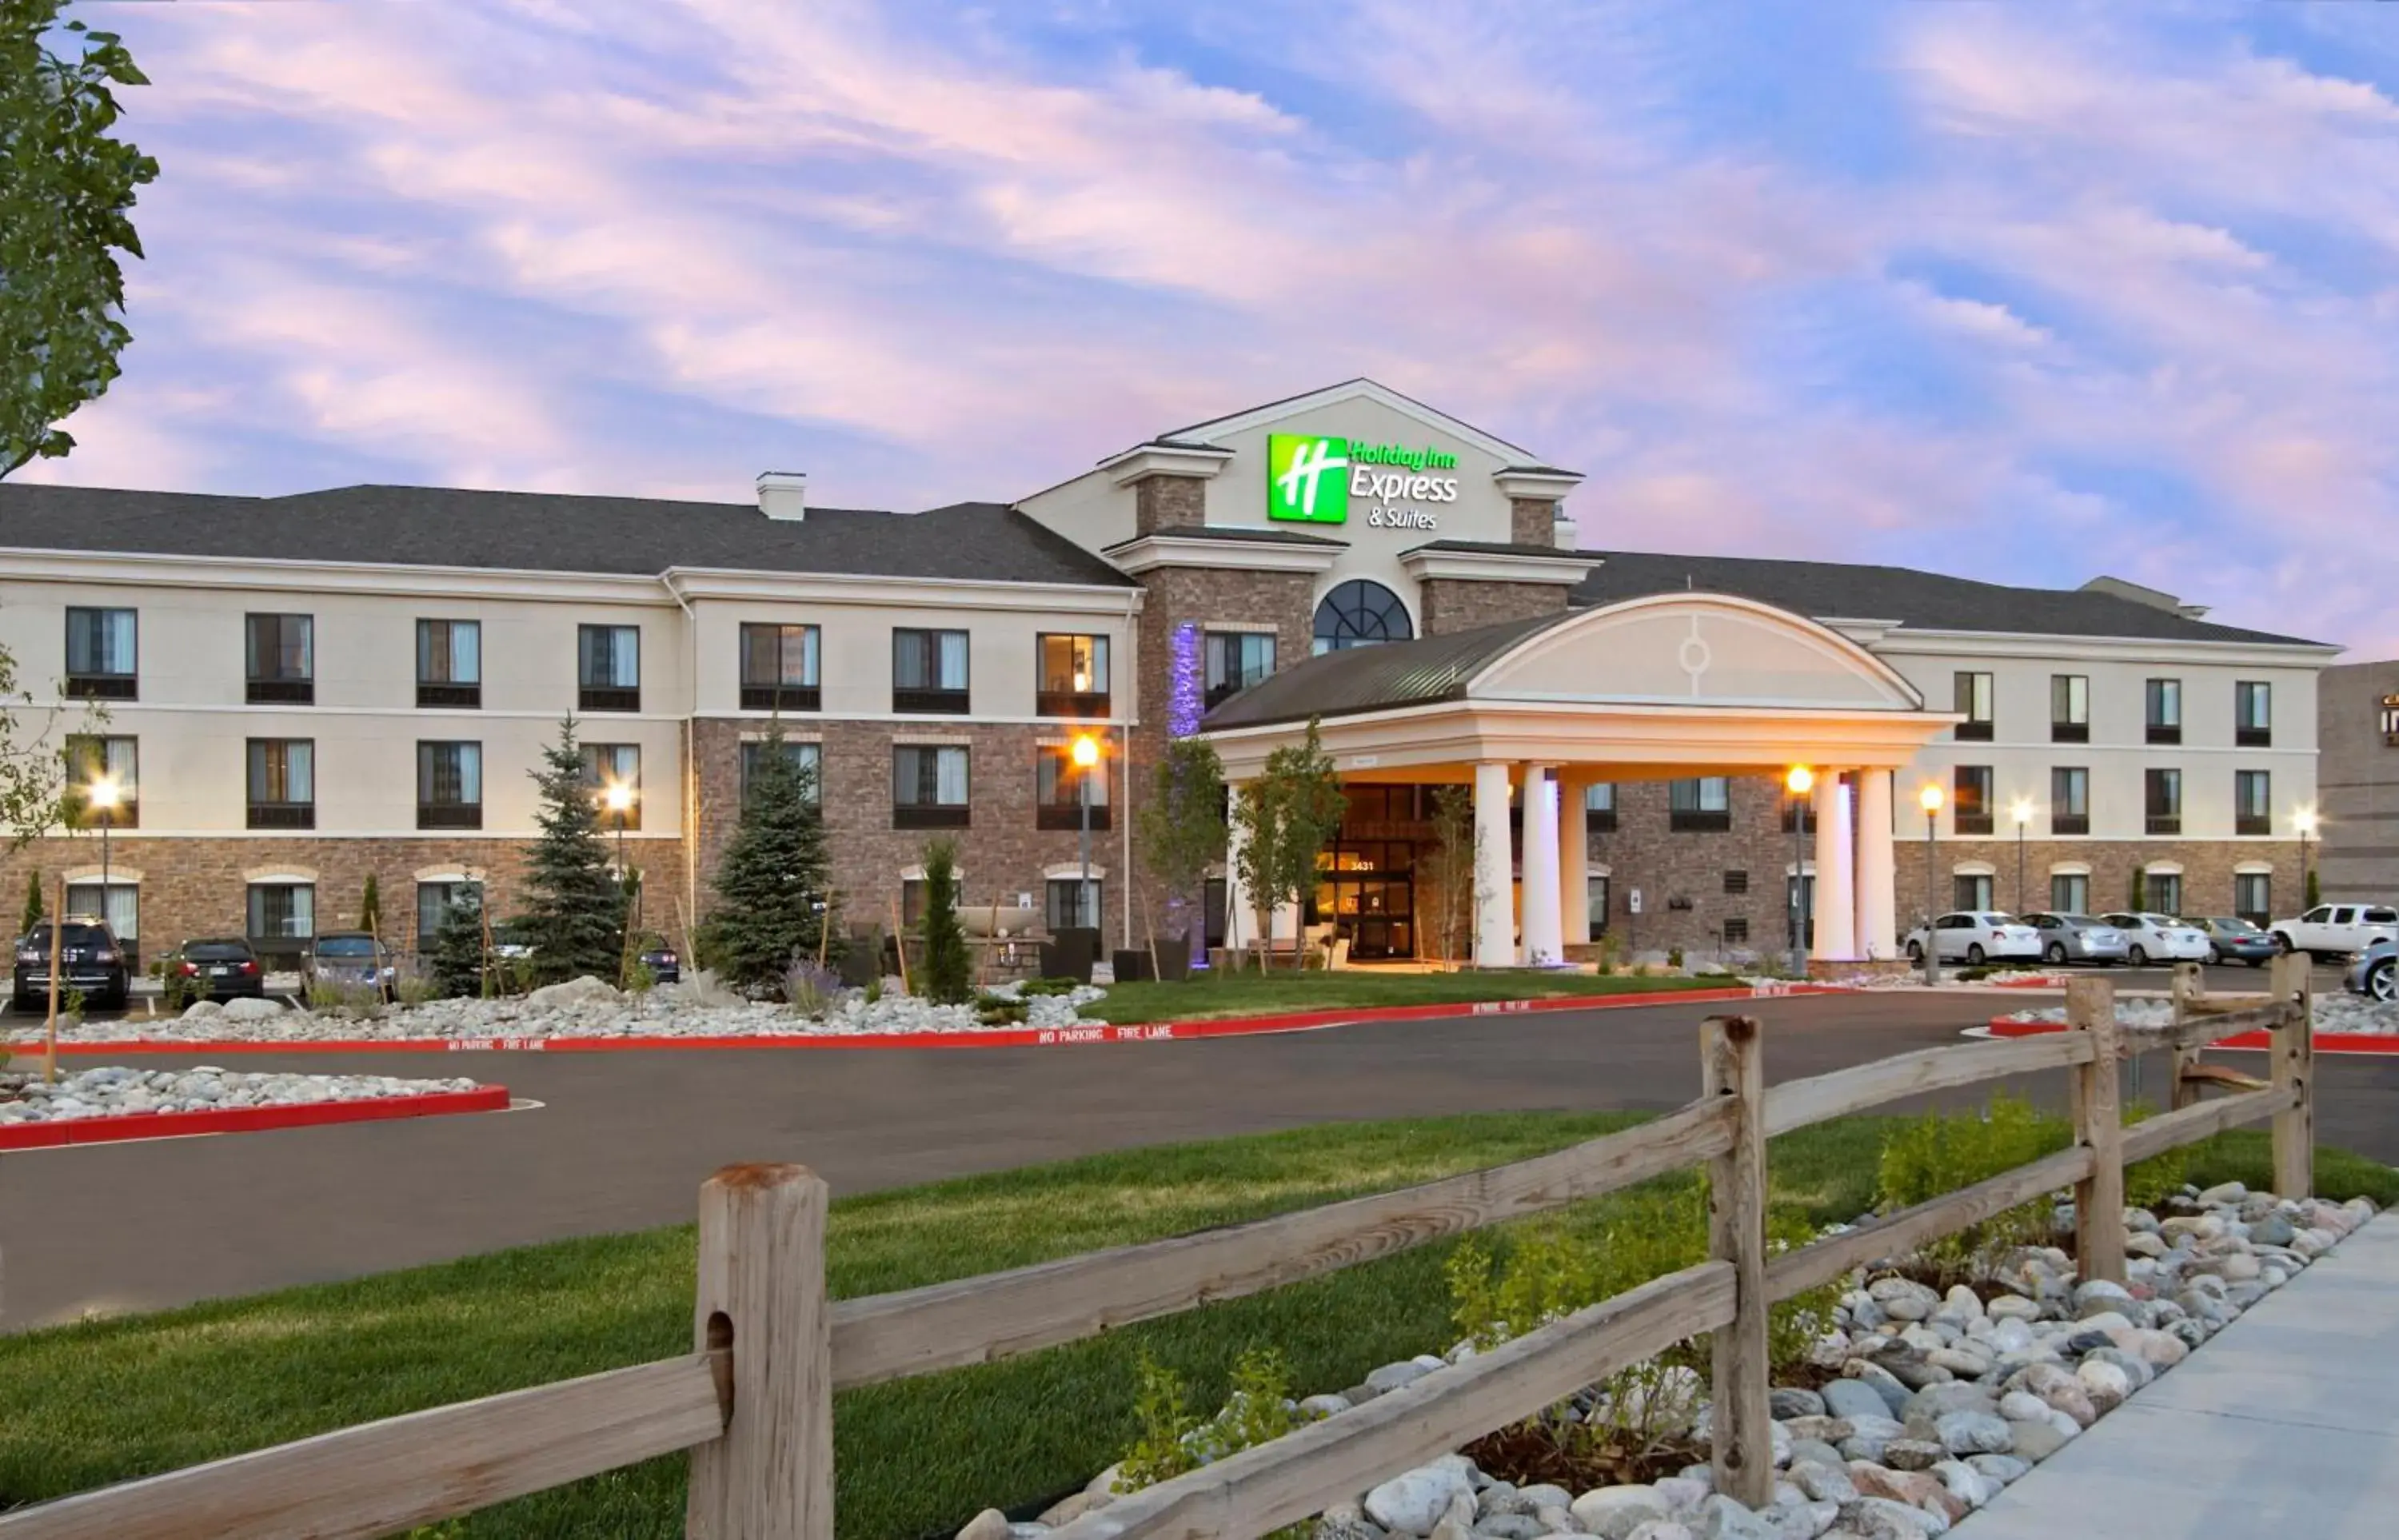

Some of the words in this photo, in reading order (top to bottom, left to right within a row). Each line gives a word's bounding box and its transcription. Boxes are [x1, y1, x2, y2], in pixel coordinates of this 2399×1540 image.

[1350, 441, 1423, 470] Holiday
[1427, 445, 1458, 469] Inn
[1350, 465, 1458, 505] Express
[1369, 507, 1381, 526] &
[1384, 509, 1437, 529] Suites
[1040, 1031, 1055, 1043] NO
[1060, 1028, 1104, 1042] PARKING
[1117, 1026, 1140, 1039] FIRE
[1145, 1023, 1172, 1038] LANE
